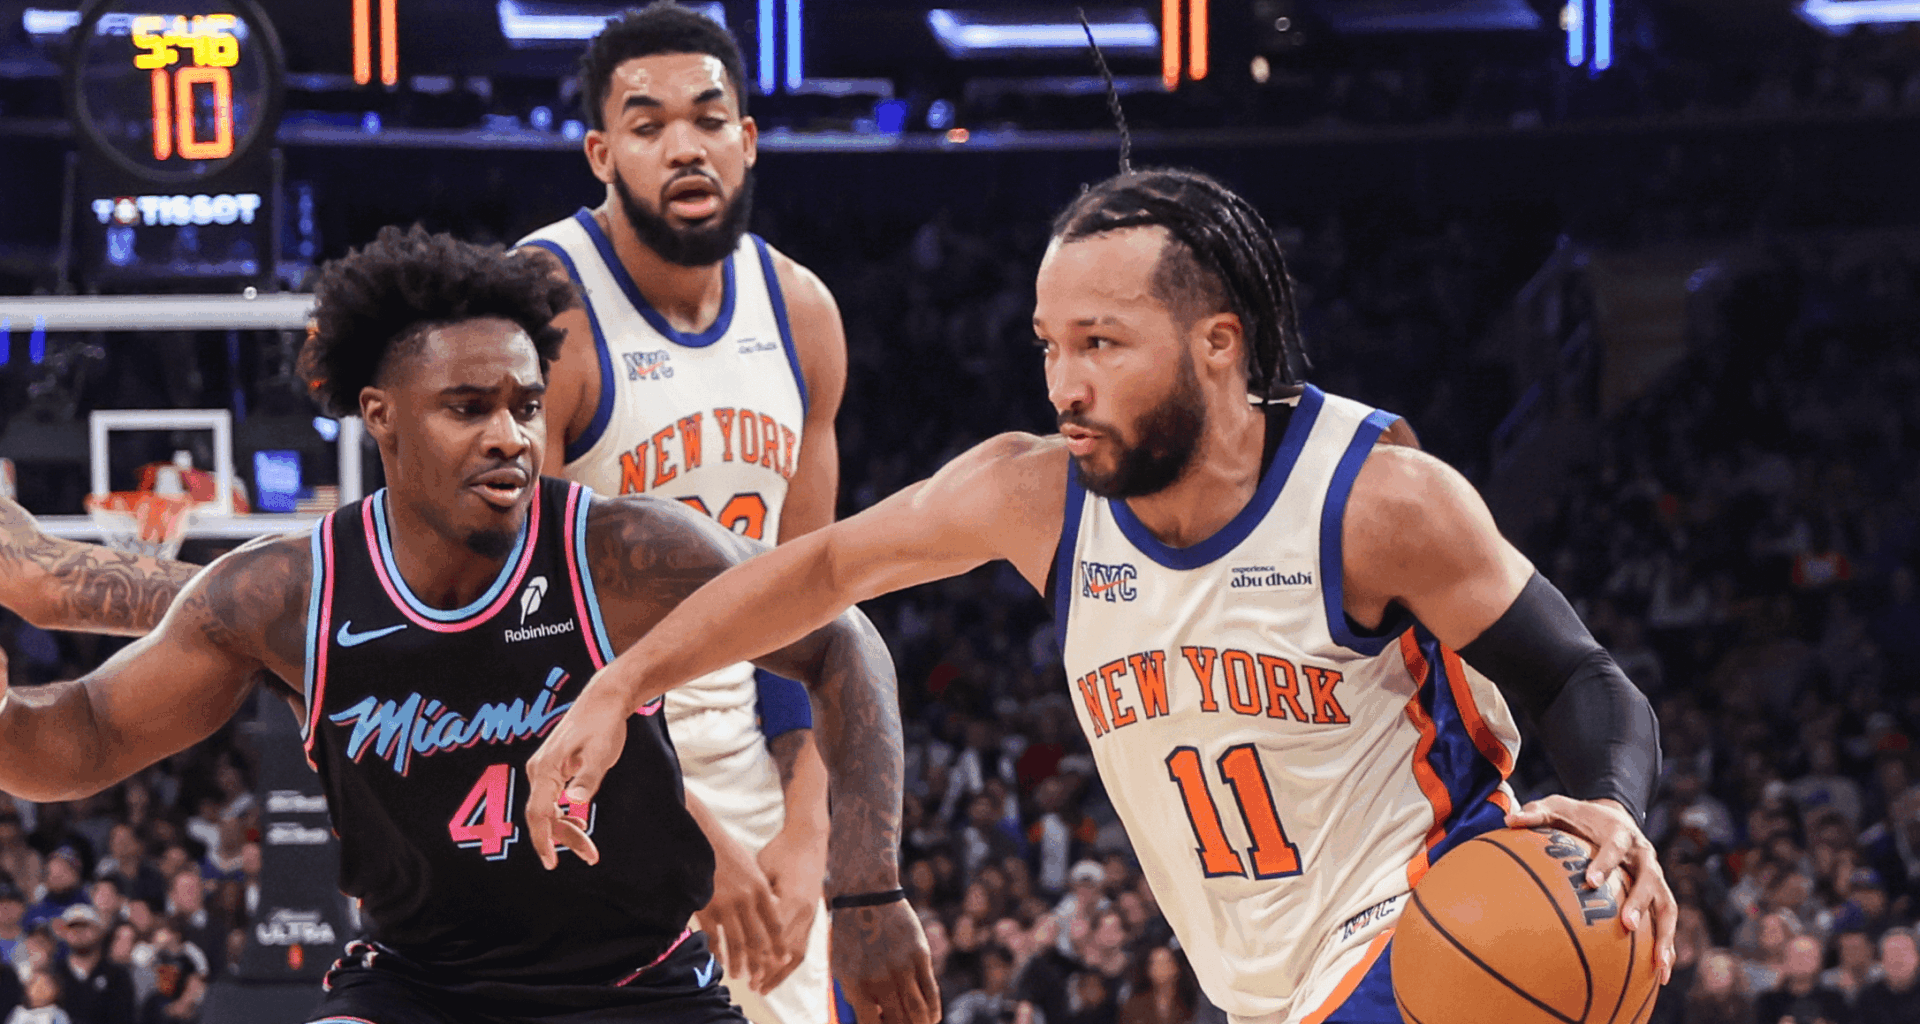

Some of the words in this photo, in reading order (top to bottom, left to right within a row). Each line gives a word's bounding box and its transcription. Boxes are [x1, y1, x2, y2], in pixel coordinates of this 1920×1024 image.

[151, 66, 235, 161] 10
[622, 349, 675, 381] NYC
[619, 410, 703, 496] NEW
[1081, 560, 1138, 603] NYC
[1230, 573, 1263, 589] abu
[1265, 570, 1313, 587] dhabi
[1231, 565, 1276, 574] experience
[504, 617, 575, 644] Robinhood
[328, 665, 576, 778] Miami
[1076, 649, 1170, 739] NEW
[1180, 646, 1351, 725] YORK
[1164, 742, 1304, 881] 11
